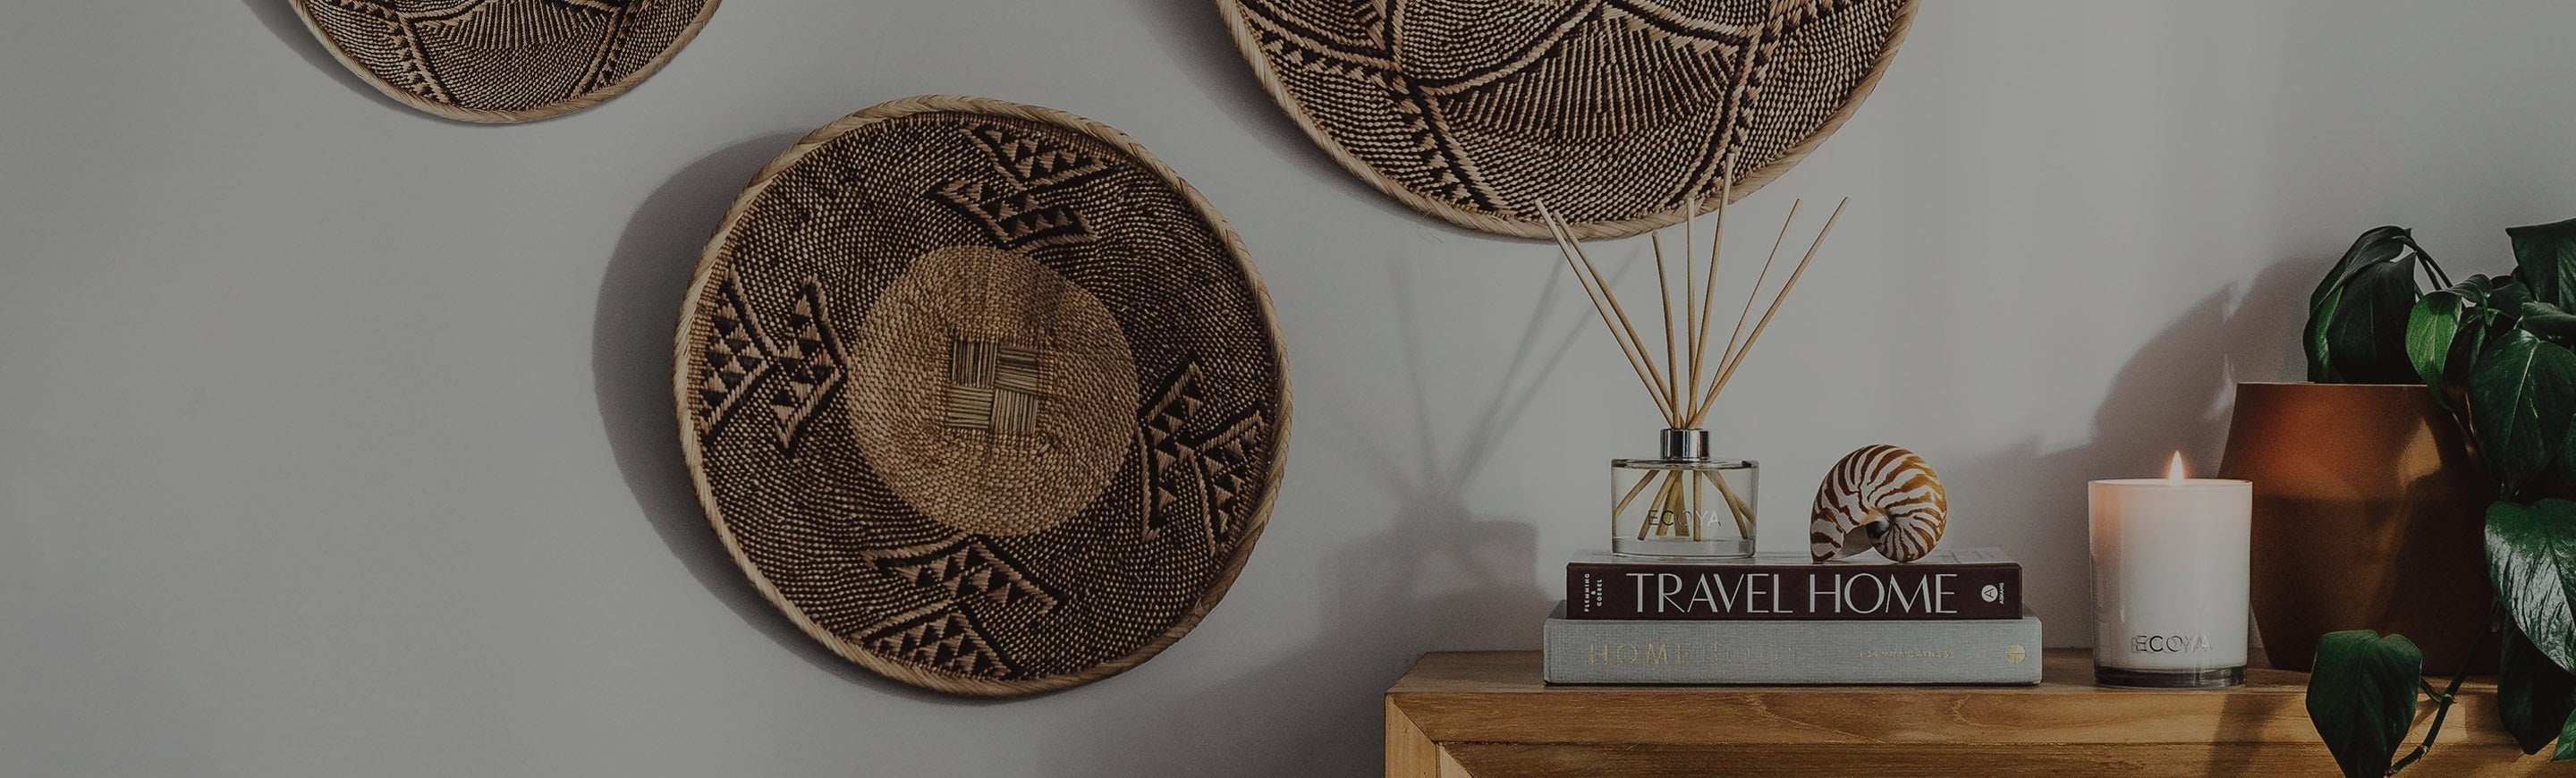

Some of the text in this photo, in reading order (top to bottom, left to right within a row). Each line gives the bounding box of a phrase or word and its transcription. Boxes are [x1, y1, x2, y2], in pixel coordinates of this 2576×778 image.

[1648, 509, 1722, 527] ECOYA
[1626, 573, 1958, 613] TRAVEL HOME
[2134, 634, 2212, 653] ECOYA
